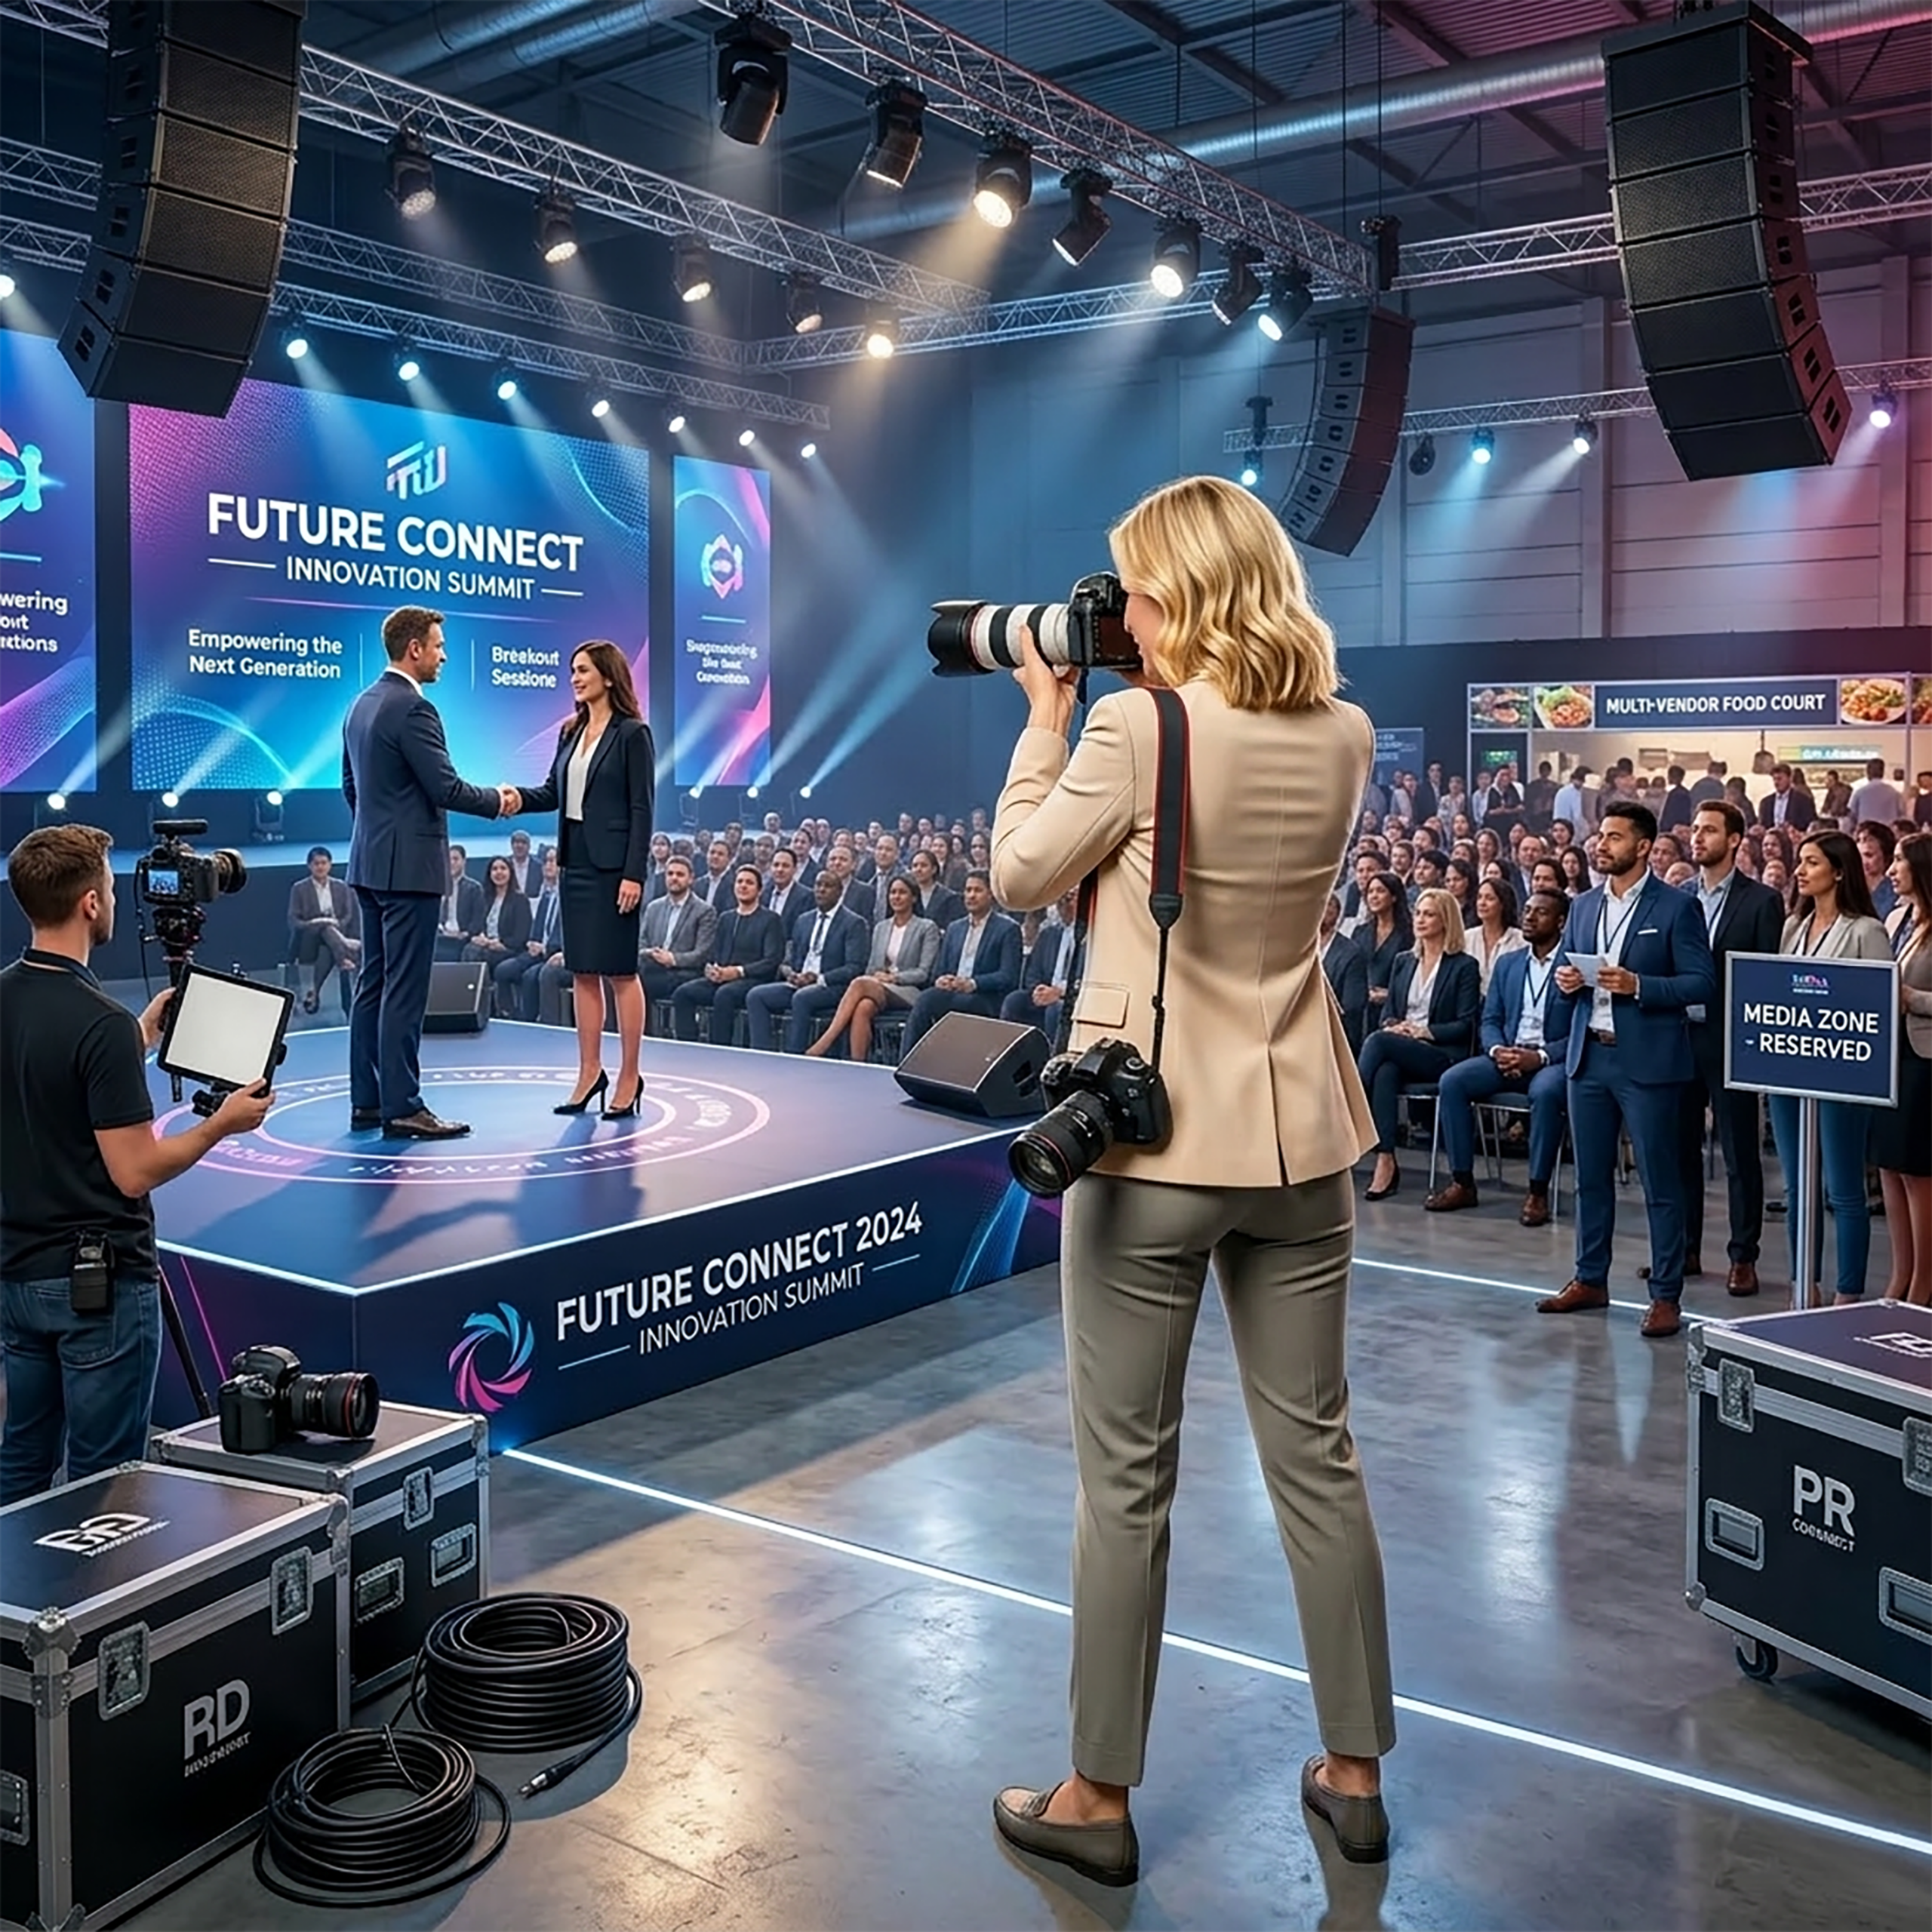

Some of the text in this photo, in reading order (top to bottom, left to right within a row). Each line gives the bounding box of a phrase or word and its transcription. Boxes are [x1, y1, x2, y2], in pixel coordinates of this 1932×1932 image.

[208, 492, 584, 572] FUTURE CONNECT
[286, 555, 535, 600] INNOVATION SUMMIT
[189, 629, 343, 657] Empowering the
[189, 655, 341, 678] Next Generation
[1606, 694, 1826, 714] MULTI-VENDOR FOOD COURT
[1744, 1002, 1879, 1034] MEDIA ZONE
[1760, 1032, 1872, 1062] RESERVED
[557, 1201, 922, 1341] FUTURE CONNECT 2024
[639, 1261, 865, 1355] INNOVATION SUMMIT
[1793, 1464, 1856, 1538] PR
[183, 1678, 251, 1761] RD
